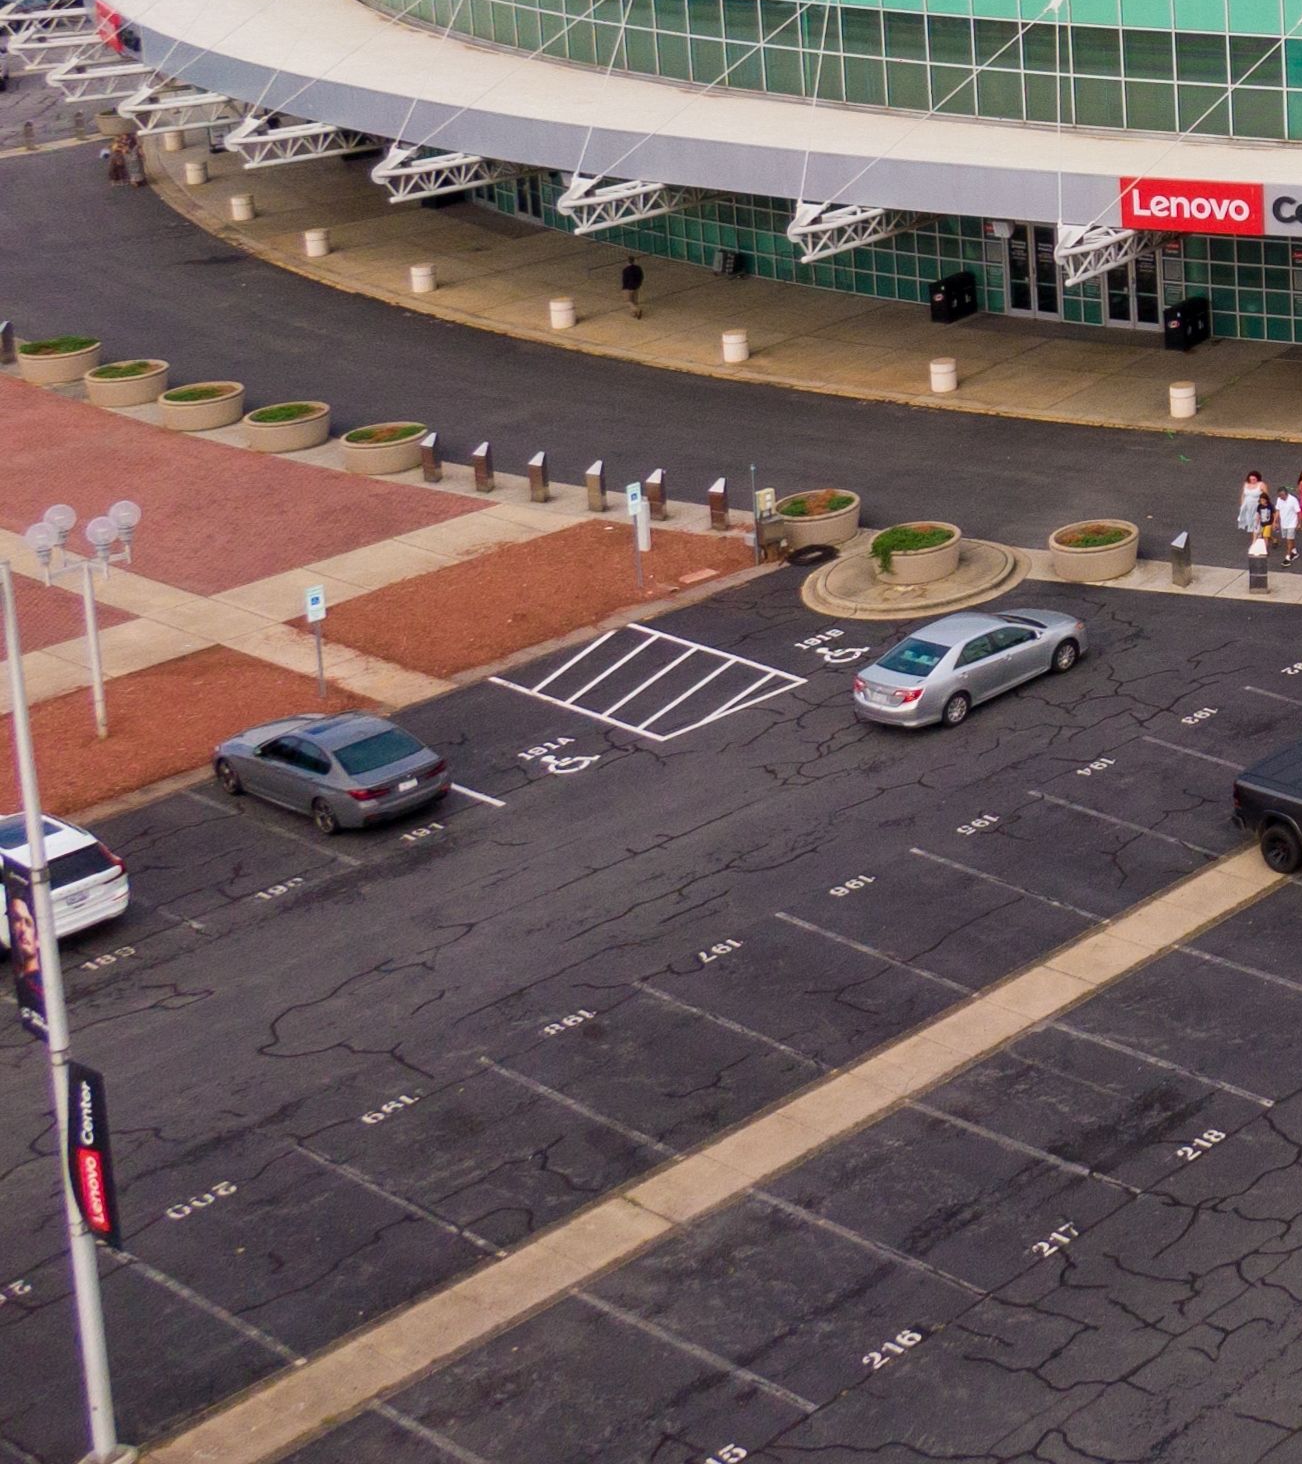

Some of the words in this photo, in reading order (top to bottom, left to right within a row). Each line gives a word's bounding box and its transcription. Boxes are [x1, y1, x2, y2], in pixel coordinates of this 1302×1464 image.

[1132, 188, 1250, 221] Lenovo
[1181, 707, 1218, 725] 193
[517, 737, 576, 762] 191A
[1076, 757, 1116, 776] 194
[400, 822, 445, 842] 191
[956, 814, 1000, 836] 195
[829, 875, 875, 897] 196
[698, 938, 742, 963] 197
[80, 1080, 94, 1146] Center
[1176, 1129, 1226, 1161] 218
[85, 1155, 105, 1224] Lenovo
[1032, 1223, 1079, 1257] 217
[862, 1329, 922, 1370] 216
